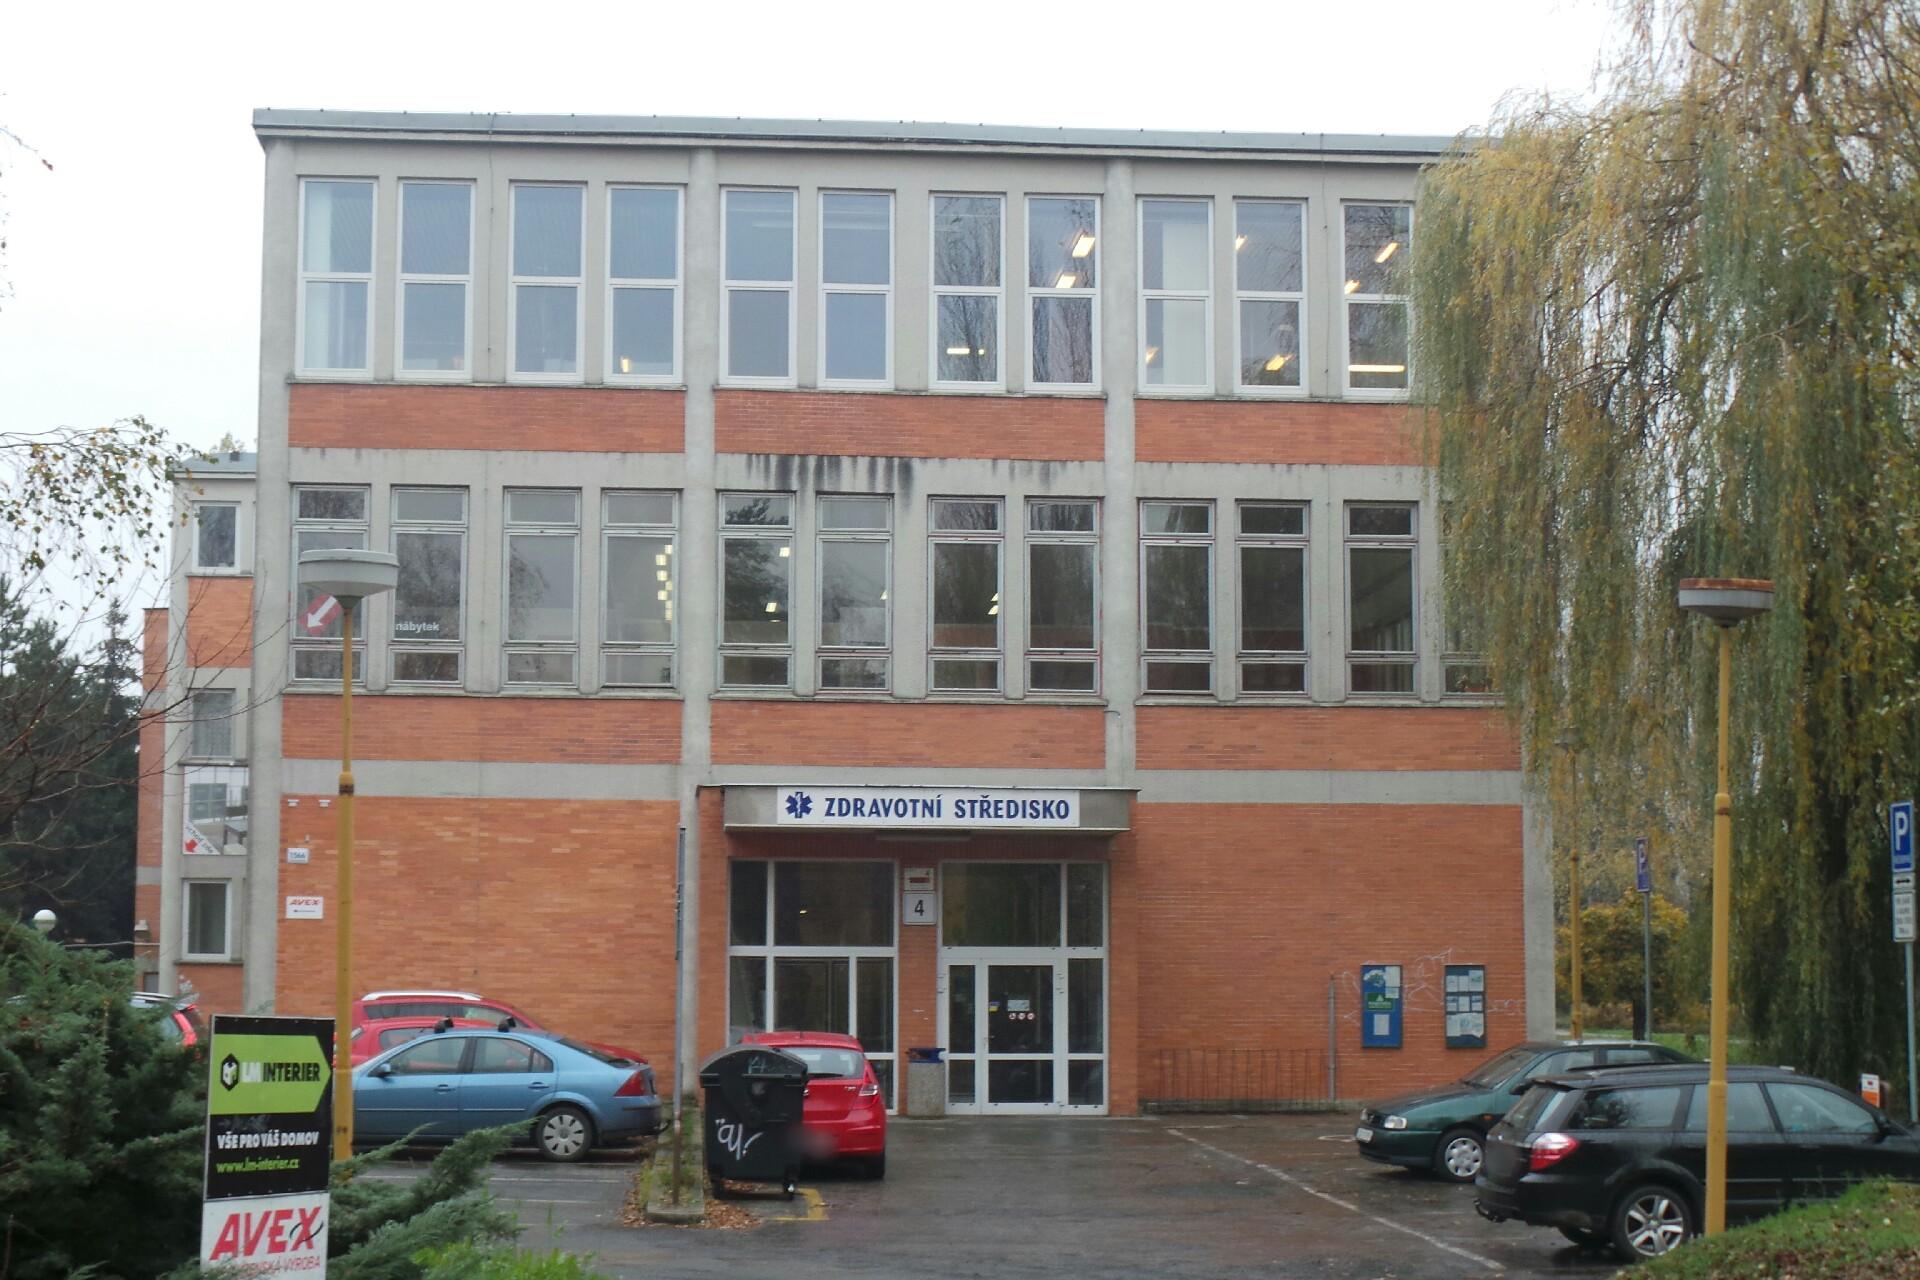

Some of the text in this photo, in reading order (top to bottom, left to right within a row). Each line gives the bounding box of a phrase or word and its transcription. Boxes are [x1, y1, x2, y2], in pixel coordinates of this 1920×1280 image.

[824, 794, 1070, 820] ZDRAVOTNÍ STŘEDISKO
[1894, 810, 1909, 851] P
[914, 899, 925, 917] 4
[217, 1129, 319, 1149] VŠE PRO VÁŠ DOMOV
[208, 1206, 322, 1261] AVEX
